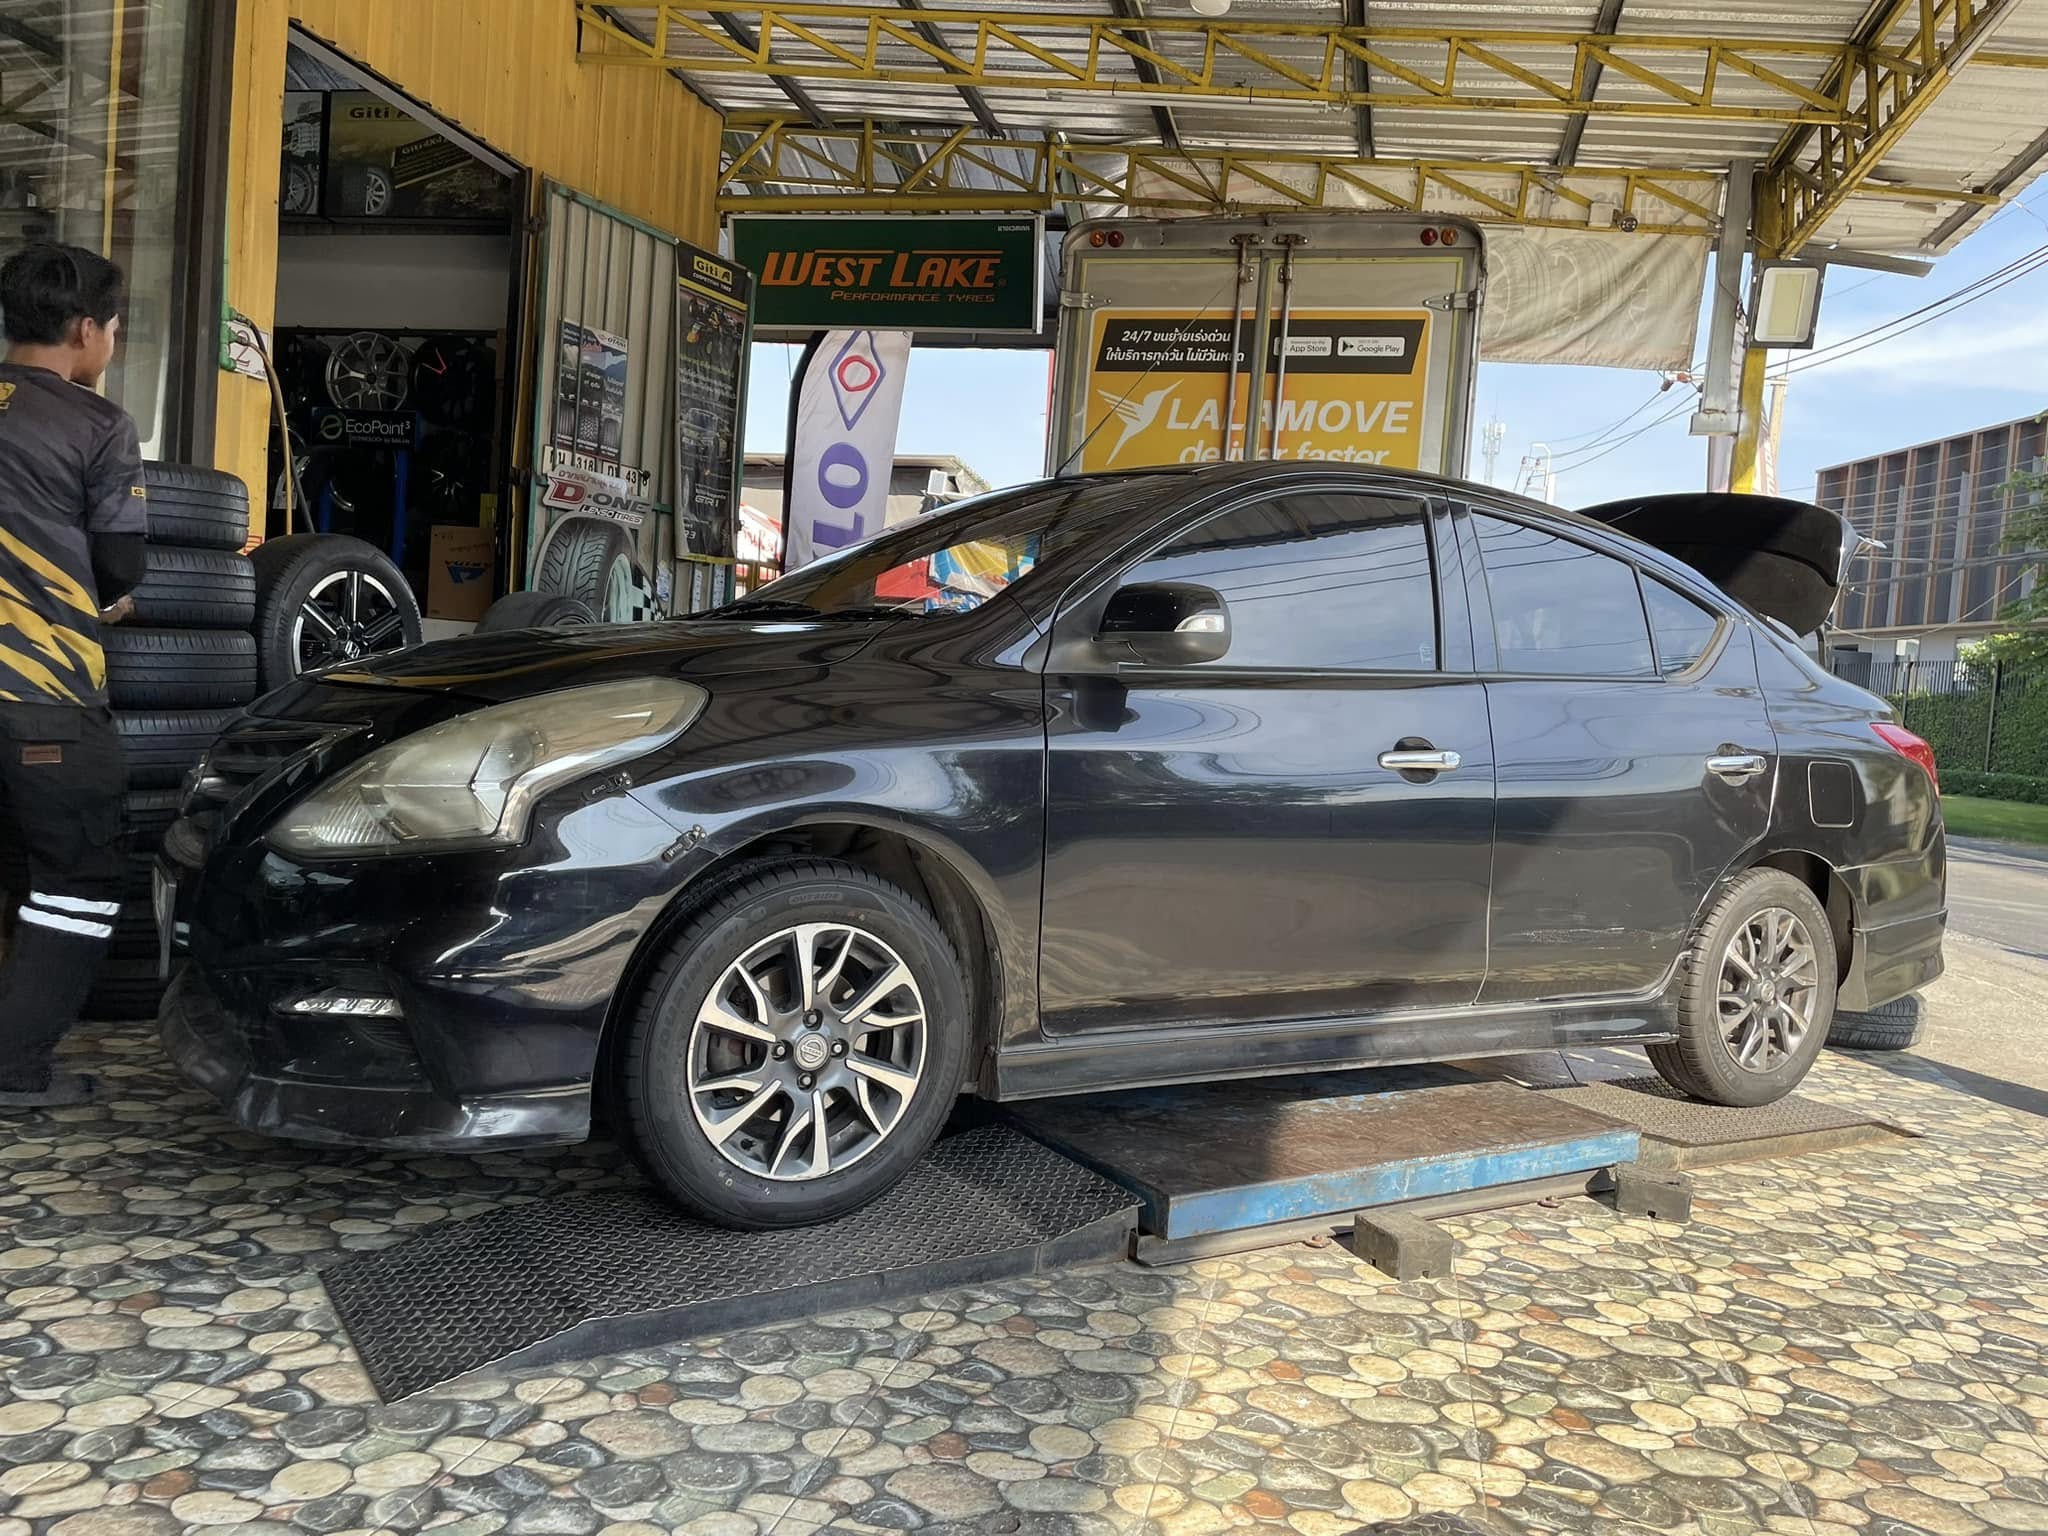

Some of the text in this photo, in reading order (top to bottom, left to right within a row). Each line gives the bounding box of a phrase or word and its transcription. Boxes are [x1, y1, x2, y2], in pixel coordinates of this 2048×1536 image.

[350, 107, 390, 119] Giti
[696, 260, 720, 278] Giti
[760, 250, 1002, 288] WEST LAKE
[830, 290, 995, 303] PERFORMANCE TYRES
[1121, 330, 1152, 344] 24/7
[1289, 344, 1328, 353] App Store
[1356, 344, 1400, 354] Google Play
[1179, 439, 1289, 464] deiver
[581, 505, 642, 523] LENSO TIRES
